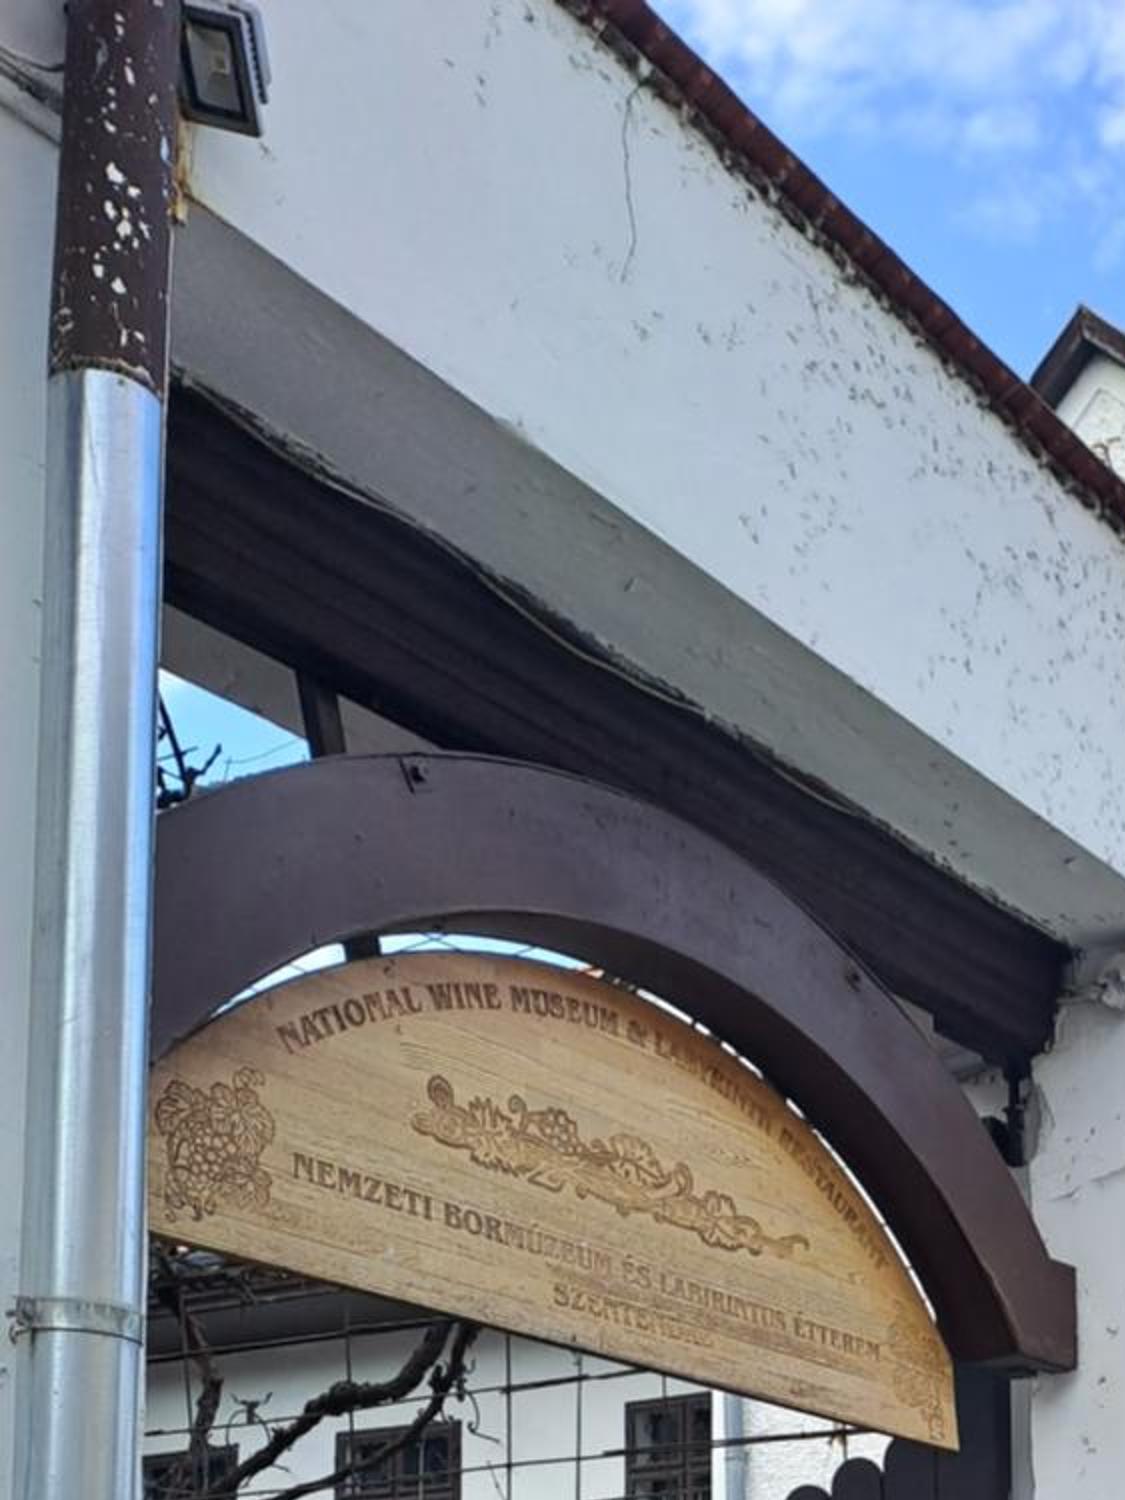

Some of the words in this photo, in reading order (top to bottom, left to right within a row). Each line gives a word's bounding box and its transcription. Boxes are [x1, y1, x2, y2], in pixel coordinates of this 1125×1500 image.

[276, 987, 423, 1054] NATIONAL
[425, 982, 501, 1011] WINE
[510, 985, 619, 1036] MUSEUM
[292, 1152, 433, 1221] NEMZETI
